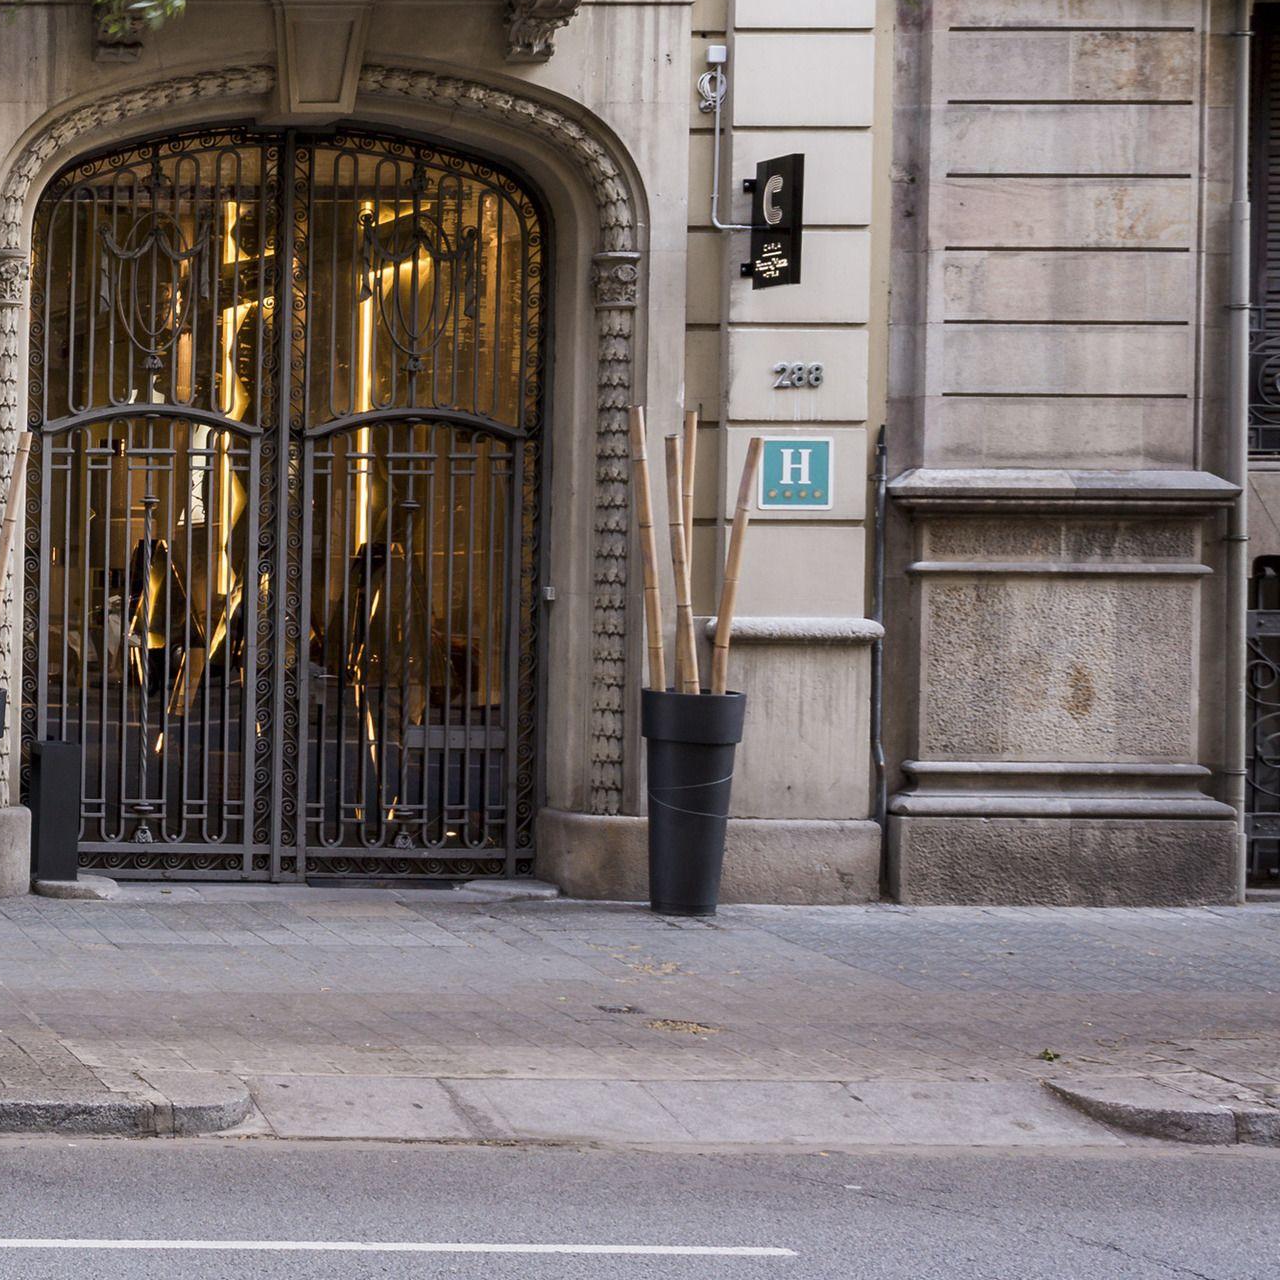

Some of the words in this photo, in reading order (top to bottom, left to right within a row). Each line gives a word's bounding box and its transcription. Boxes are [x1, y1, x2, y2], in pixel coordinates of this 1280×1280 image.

[763, 174, 783, 225] C
[771, 361, 824, 388] 288
[779, 448, 812, 484] H
